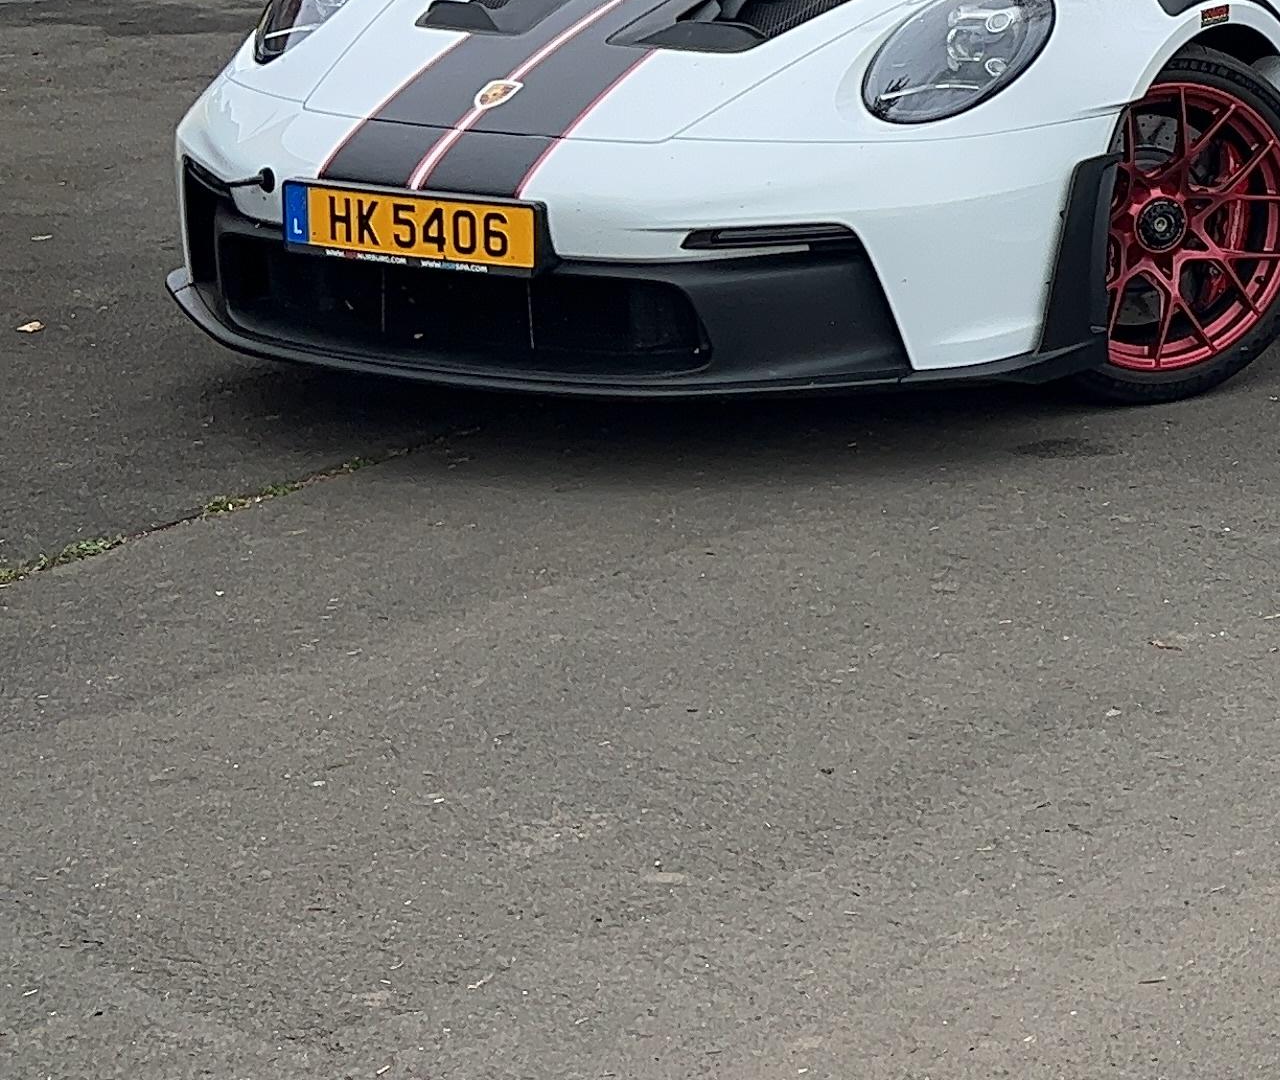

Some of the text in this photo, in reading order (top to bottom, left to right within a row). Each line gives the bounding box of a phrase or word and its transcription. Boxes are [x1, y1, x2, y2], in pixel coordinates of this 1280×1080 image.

[292, 217, 303, 236] L
[328, 195, 510, 257] HK 5406
